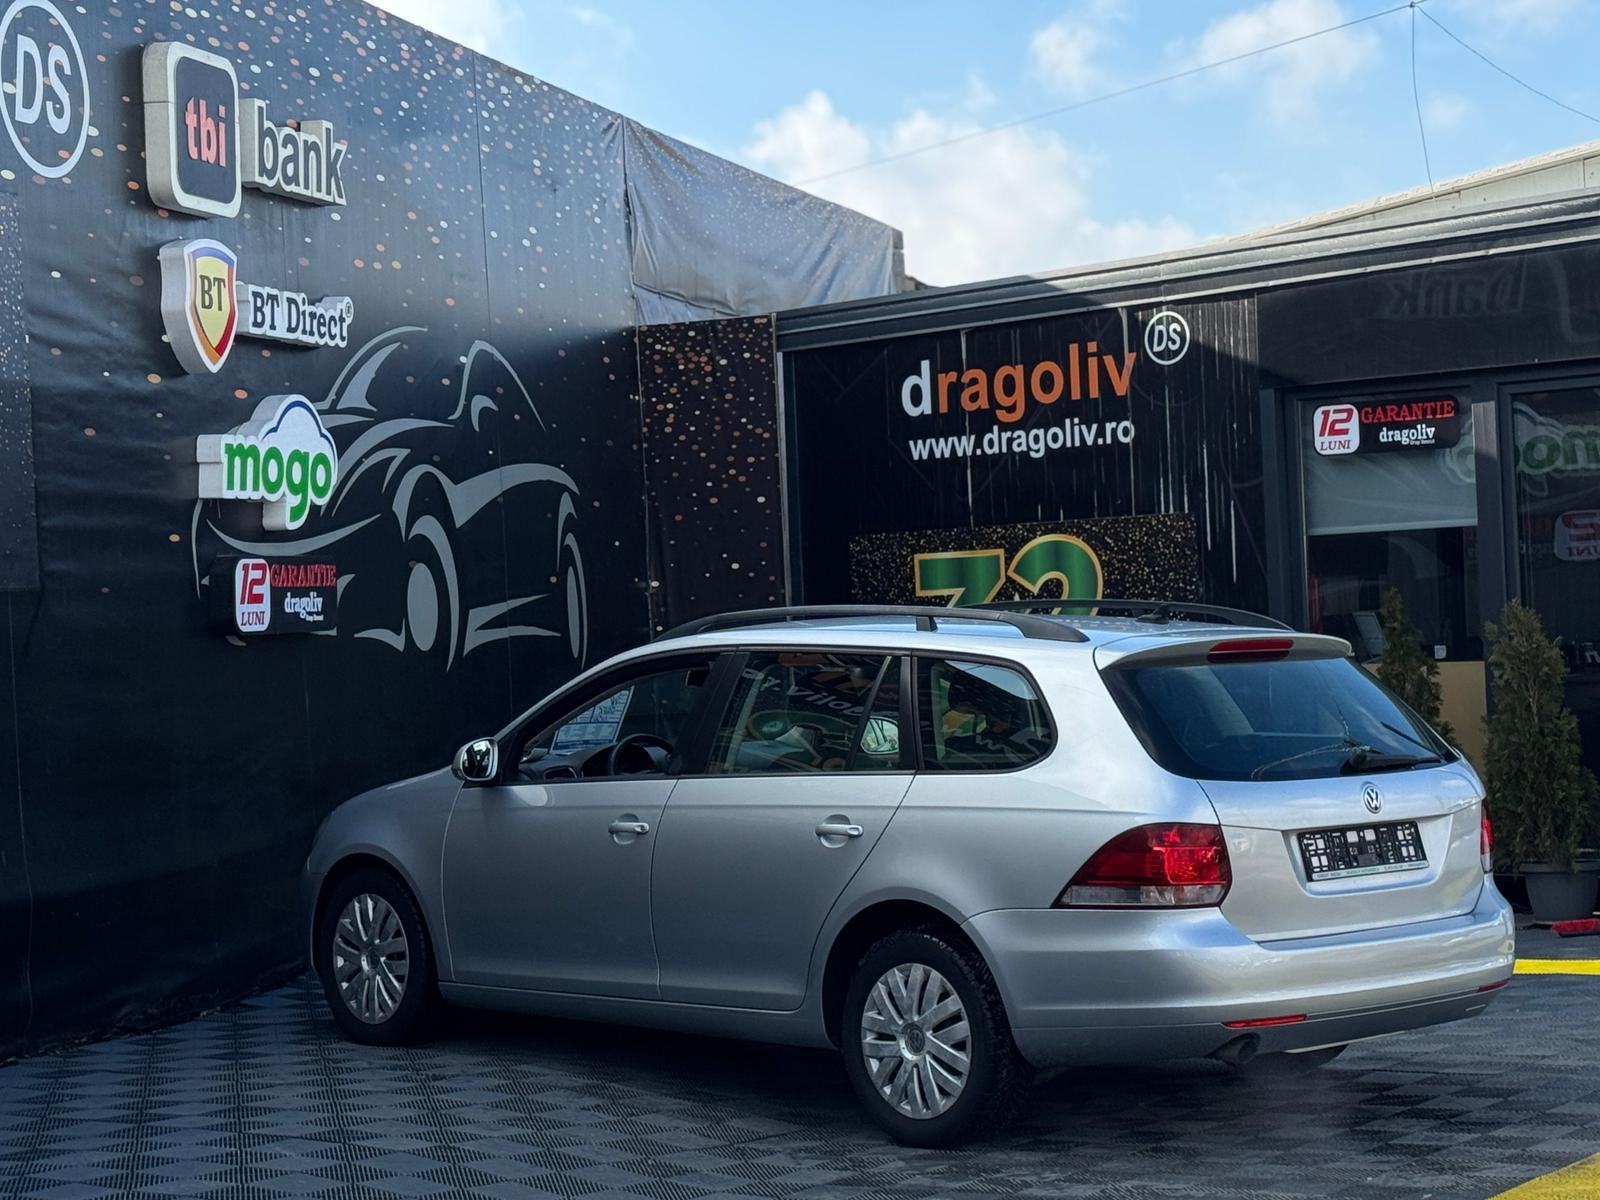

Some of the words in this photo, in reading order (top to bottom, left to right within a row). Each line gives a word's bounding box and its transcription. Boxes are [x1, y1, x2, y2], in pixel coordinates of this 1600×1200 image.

[15, 33, 72, 135] DS
[185, 96, 226, 168] tbi
[257, 104, 346, 200] bank
[199, 274, 226, 312] BT
[251, 291, 281, 331] BT
[1152, 322, 1182, 352] DS
[901, 341, 1137, 423] dragoliv
[1318, 407, 1354, 437] 12
[1361, 401, 1455, 423] GARANTIE
[908, 417, 1136, 461] www.dragoliv.ro
[1320, 439, 1352, 451] LUNI
[1379, 424, 1436, 446] dragoliv
[224, 443, 332, 523] mogo
[240, 563, 267, 605] 12
[270, 564, 337, 588] GARANTIE
[240, 611, 266, 626] LUNI
[284, 592, 323, 619] dragoliv
